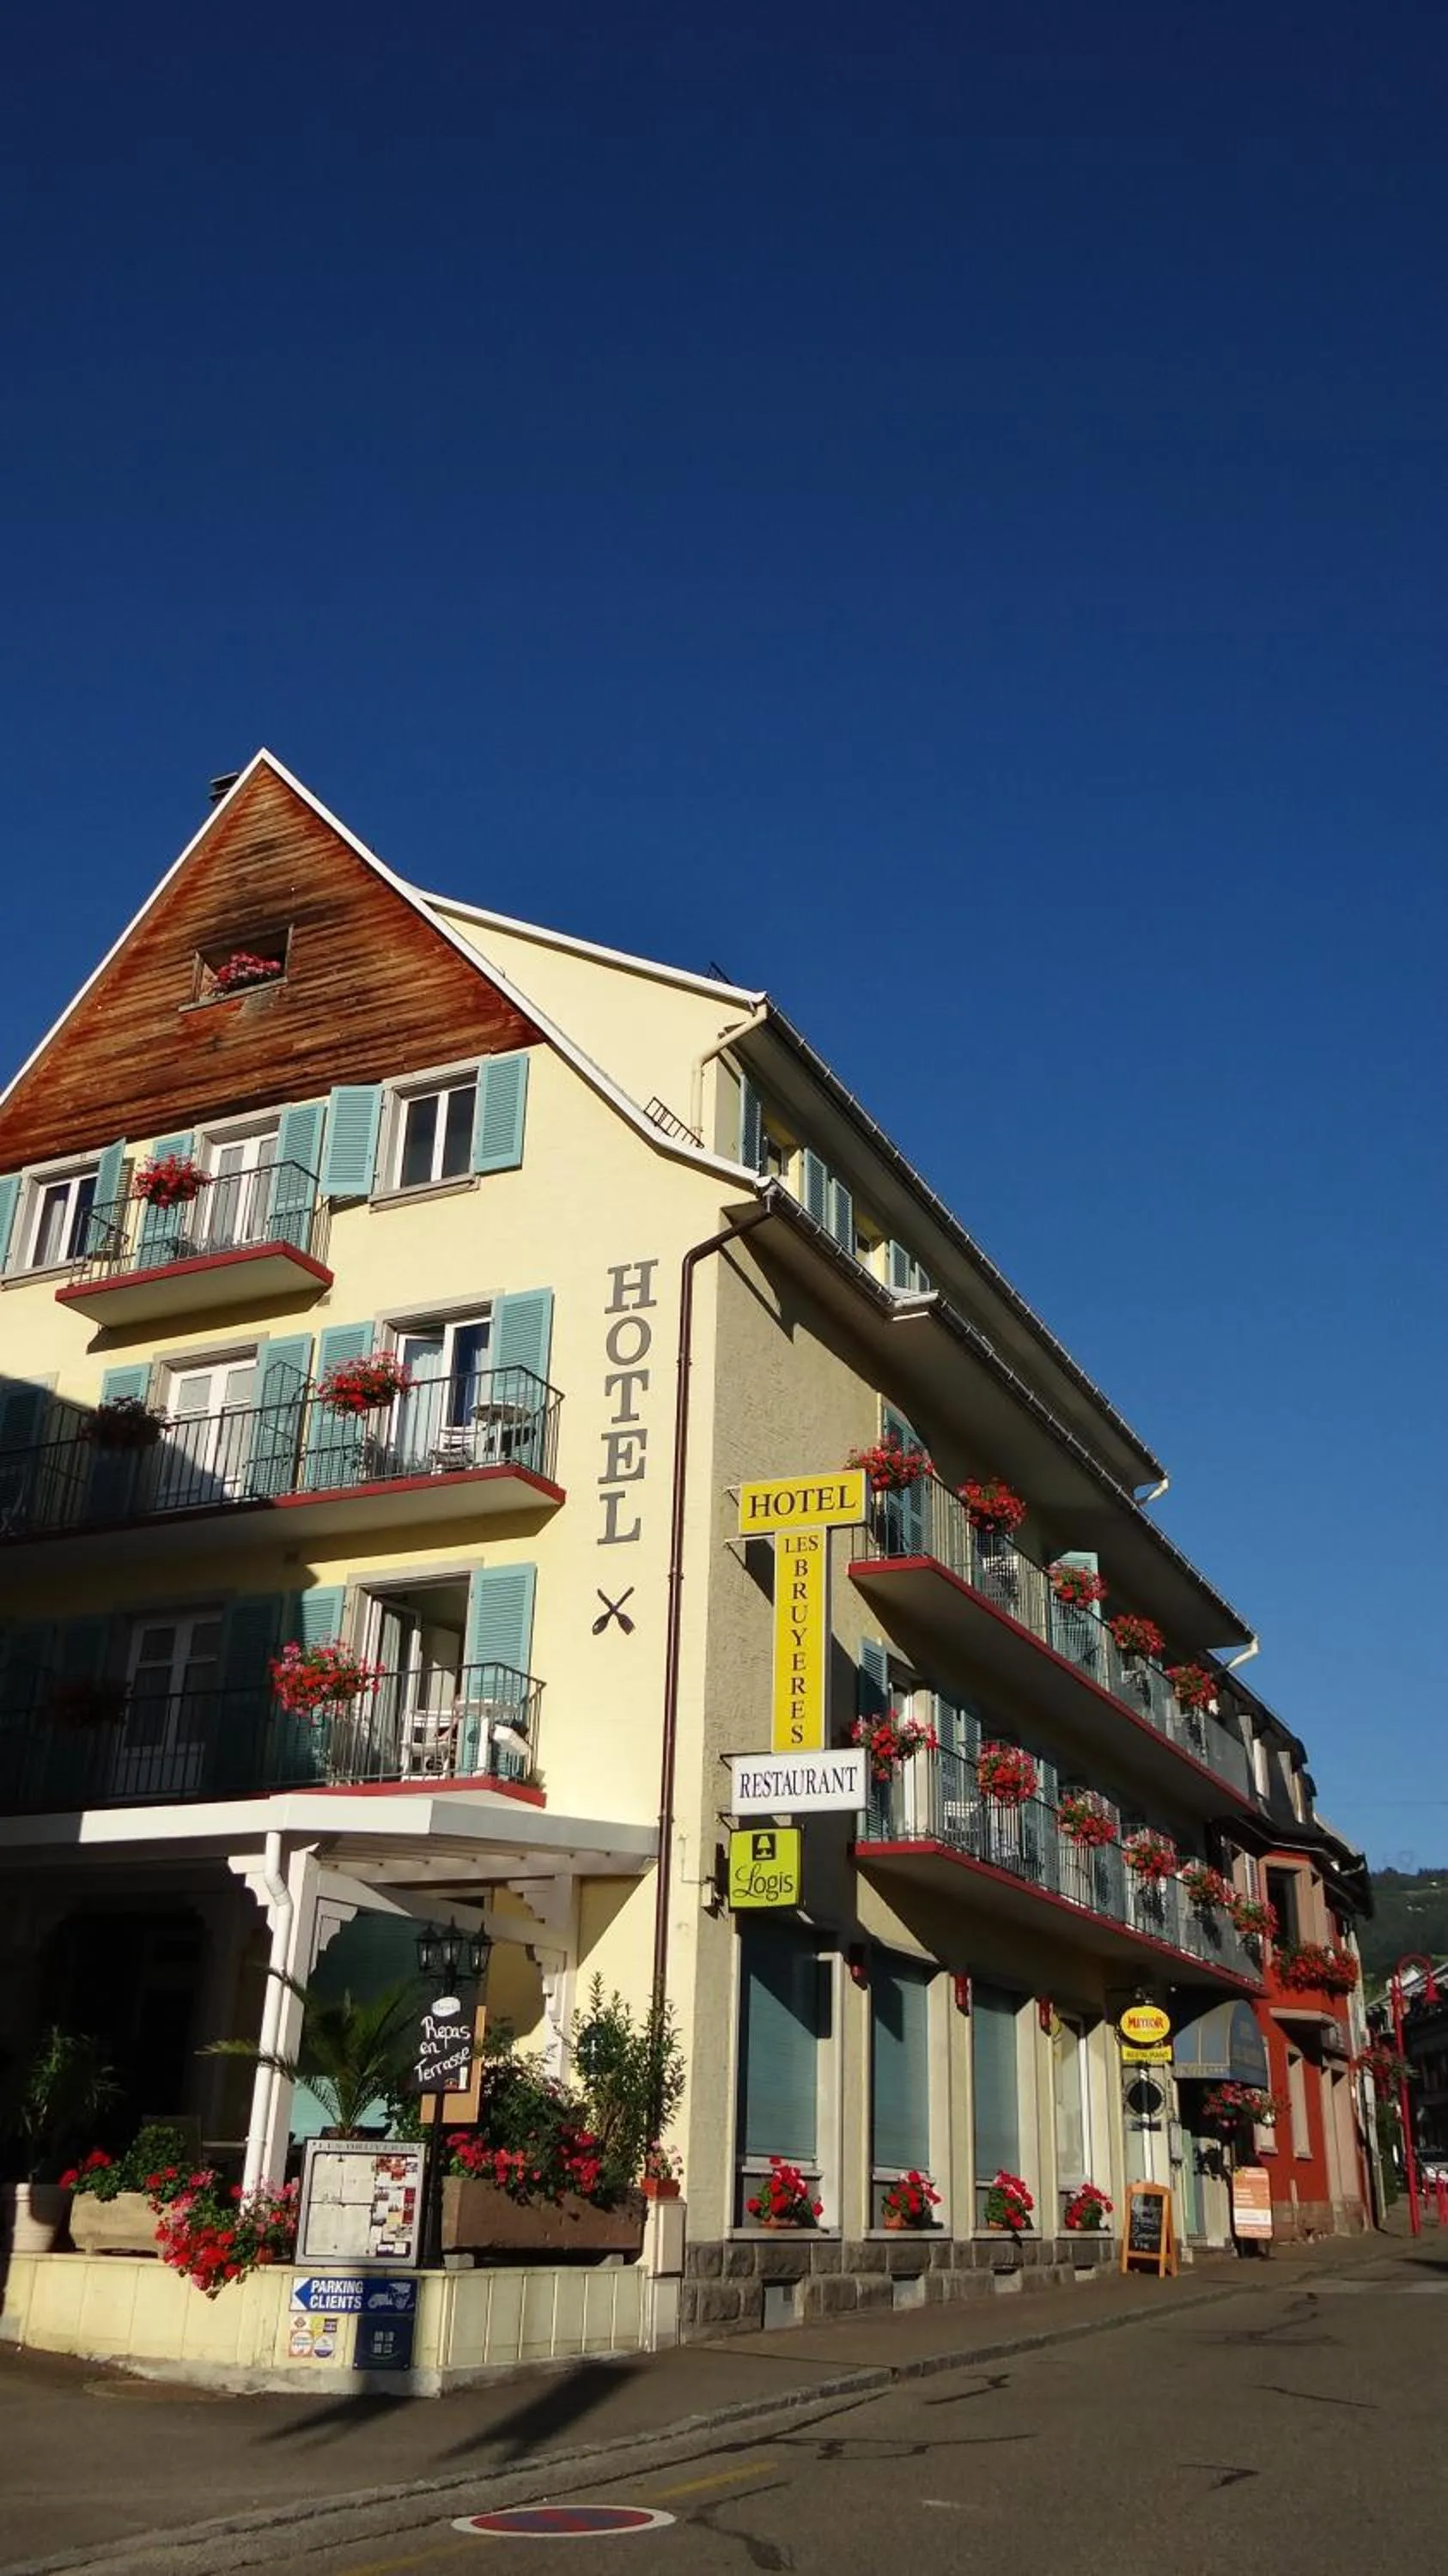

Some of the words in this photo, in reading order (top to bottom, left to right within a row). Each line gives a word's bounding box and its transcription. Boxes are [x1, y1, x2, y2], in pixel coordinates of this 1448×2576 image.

[596, 1259, 659, 1545] HOTEL
[748, 1485, 856, 1519] HOTEL
[784, 1534, 818, 1553] LES
[790, 1558, 809, 1745] BRUYERES
[739, 1766, 857, 1799] RESTAURANT
[733, 1862, 794, 1902] Logis
[420, 2015, 471, 2050] Repas
[420, 2041, 441, 2055] en
[414, 2046, 471, 2082] Terrasse
[309, 2295, 362, 2309] CLIENTS
[311, 2280, 364, 2293] PARKING
